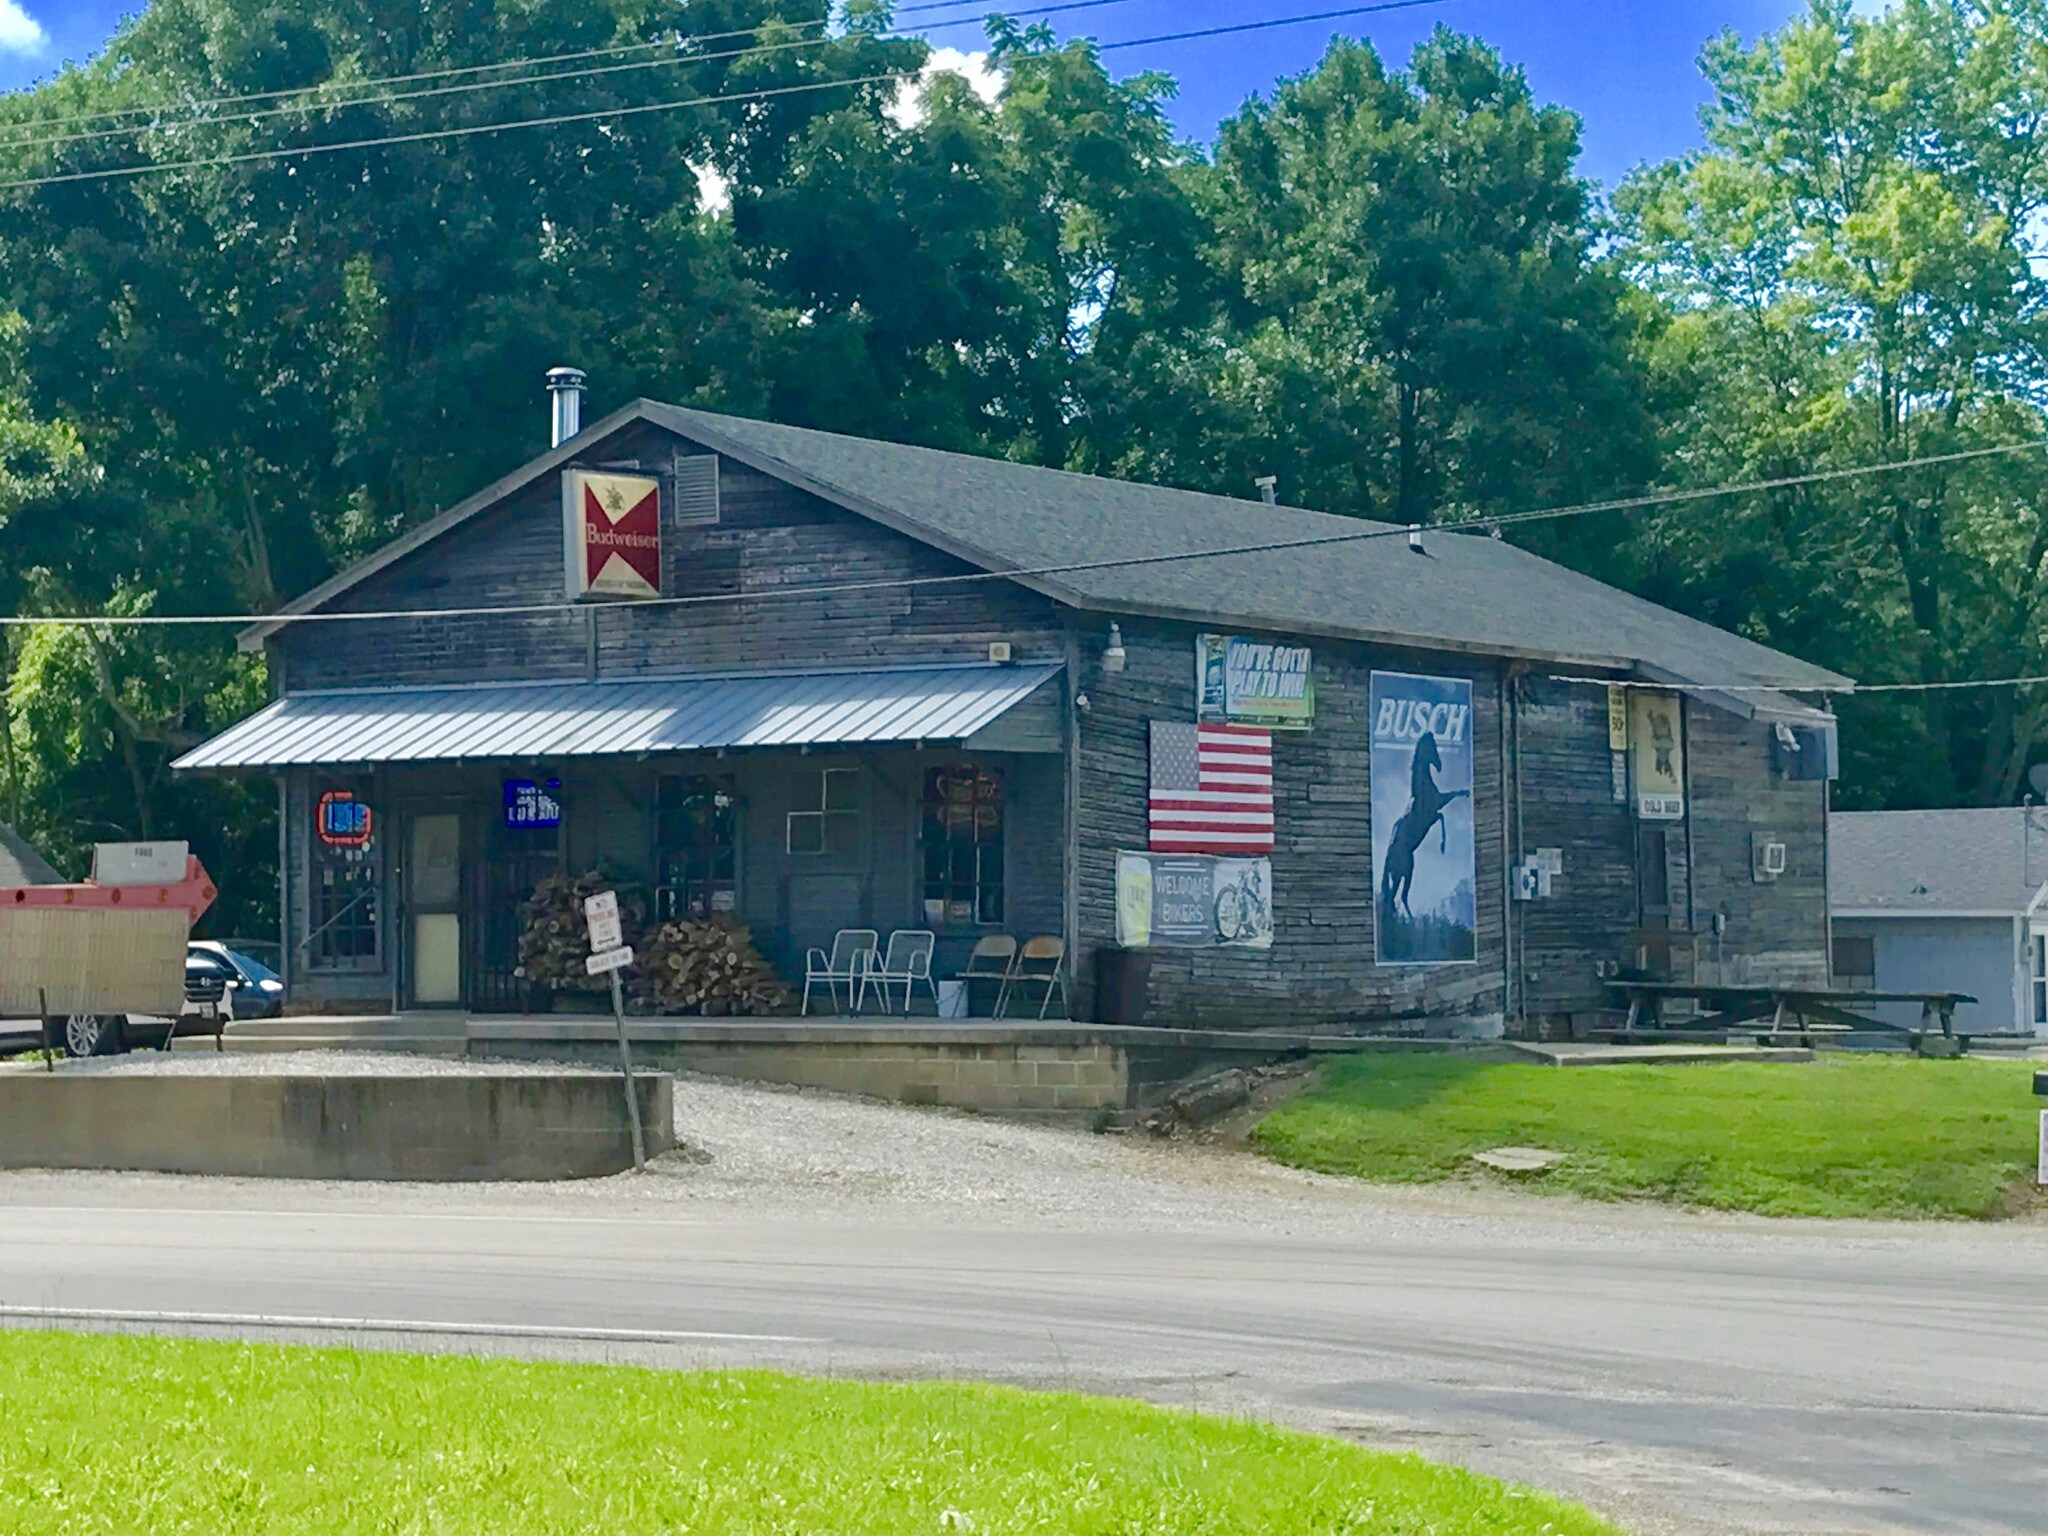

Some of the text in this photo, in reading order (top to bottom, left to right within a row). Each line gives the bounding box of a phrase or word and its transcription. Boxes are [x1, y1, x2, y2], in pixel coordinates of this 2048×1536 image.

[586, 523, 659, 549] Budweiser
[1230, 642, 1273, 671] YOU'VE
[1230, 669, 1262, 697] PLAY
[1260, 670, 1279, 697] TO
[1374, 697, 1468, 742] BUSCH
[1154, 873, 1211, 896] WELCOME
[1162, 901, 1205, 923] BIKERS
